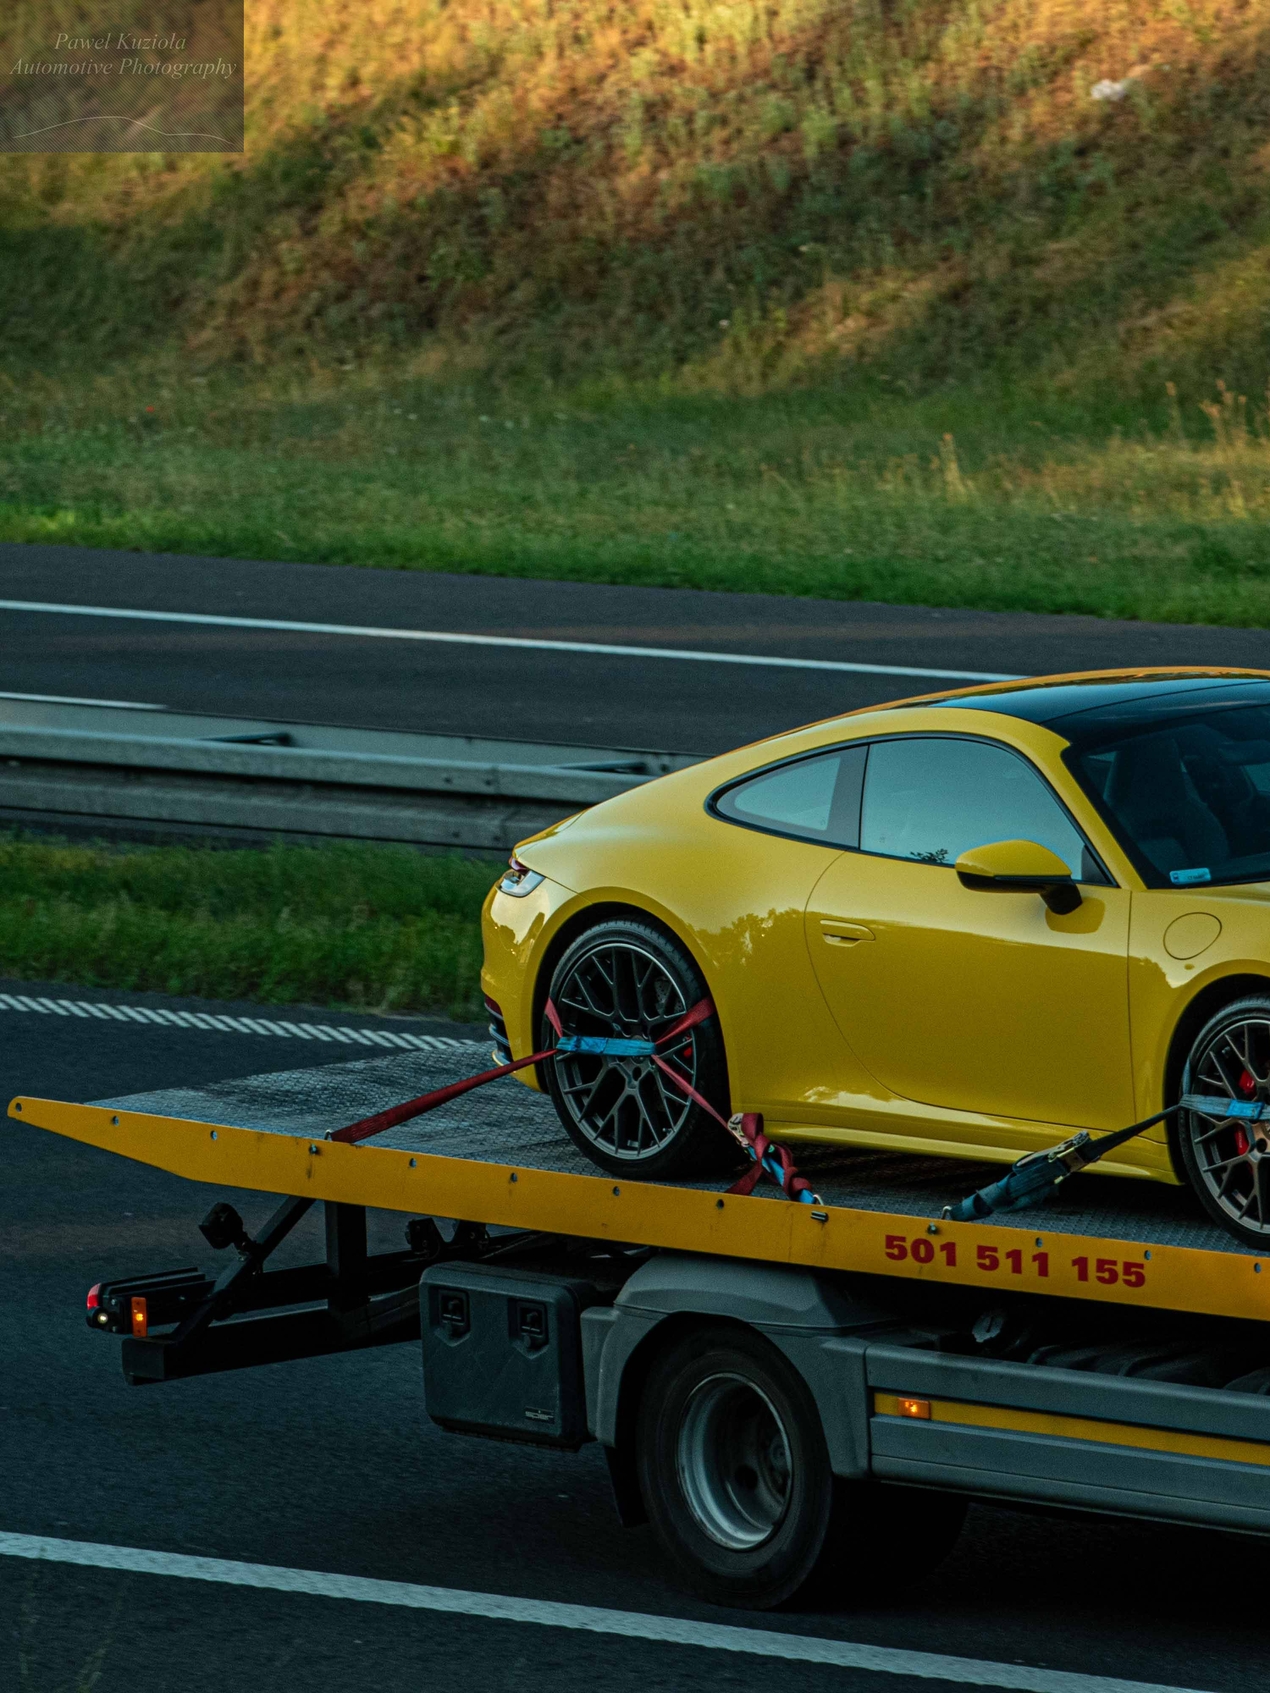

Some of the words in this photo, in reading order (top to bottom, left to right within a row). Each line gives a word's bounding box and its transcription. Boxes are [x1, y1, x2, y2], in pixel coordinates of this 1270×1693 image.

[885, 1234, 957, 1267] 501
[976, 1244, 1049, 1277] 511
[1071, 1256, 1146, 1288] 155
